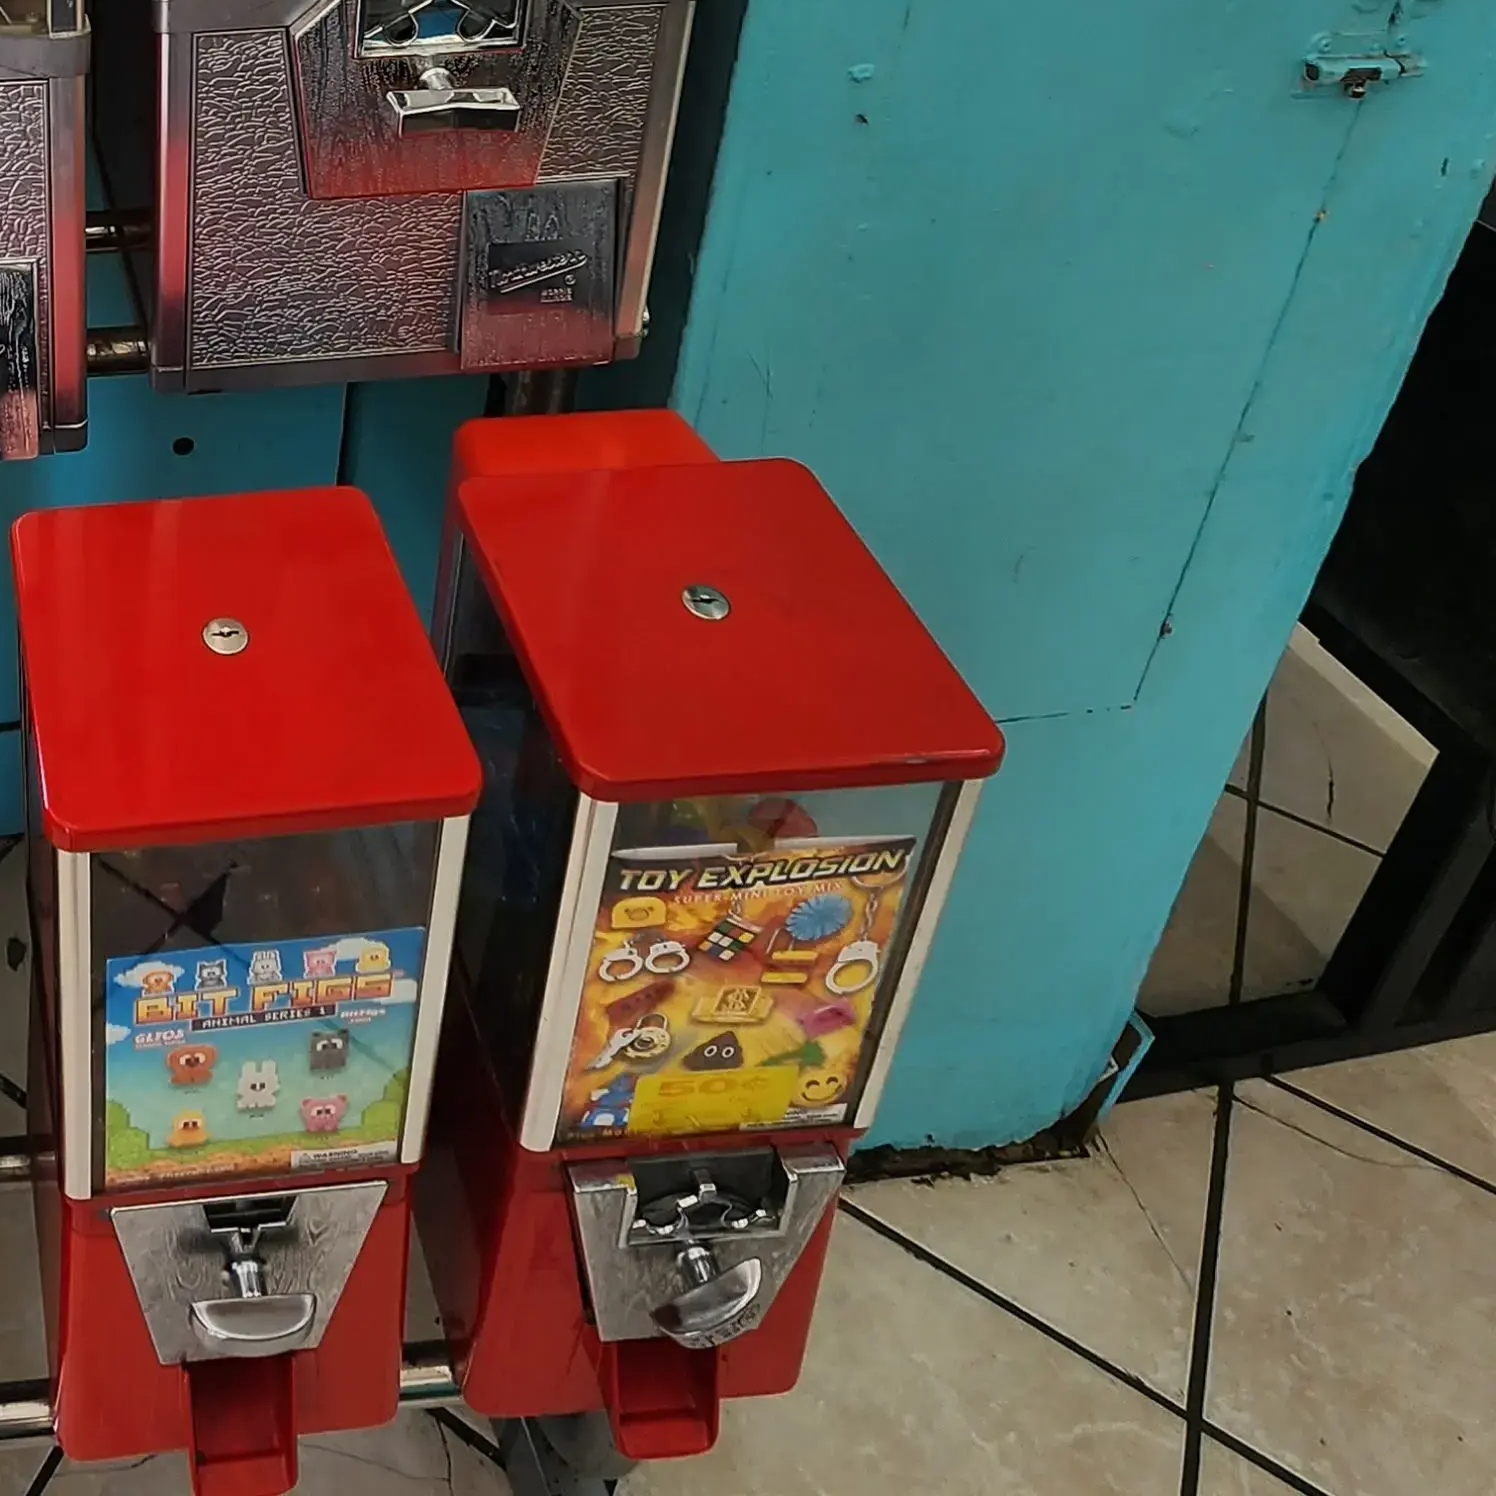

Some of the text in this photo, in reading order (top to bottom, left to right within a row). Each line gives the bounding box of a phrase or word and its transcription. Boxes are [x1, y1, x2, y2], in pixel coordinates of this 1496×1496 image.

[619, 849, 905, 891] TOY EXPLOSION
[673, 892, 723, 905] SUPER
[730, 888, 770, 901] MINI
[811, 880, 844, 893] MIX
[135, 973, 394, 1025] BIT FIGS
[202, 1012, 257, 1029] ANIMAL
